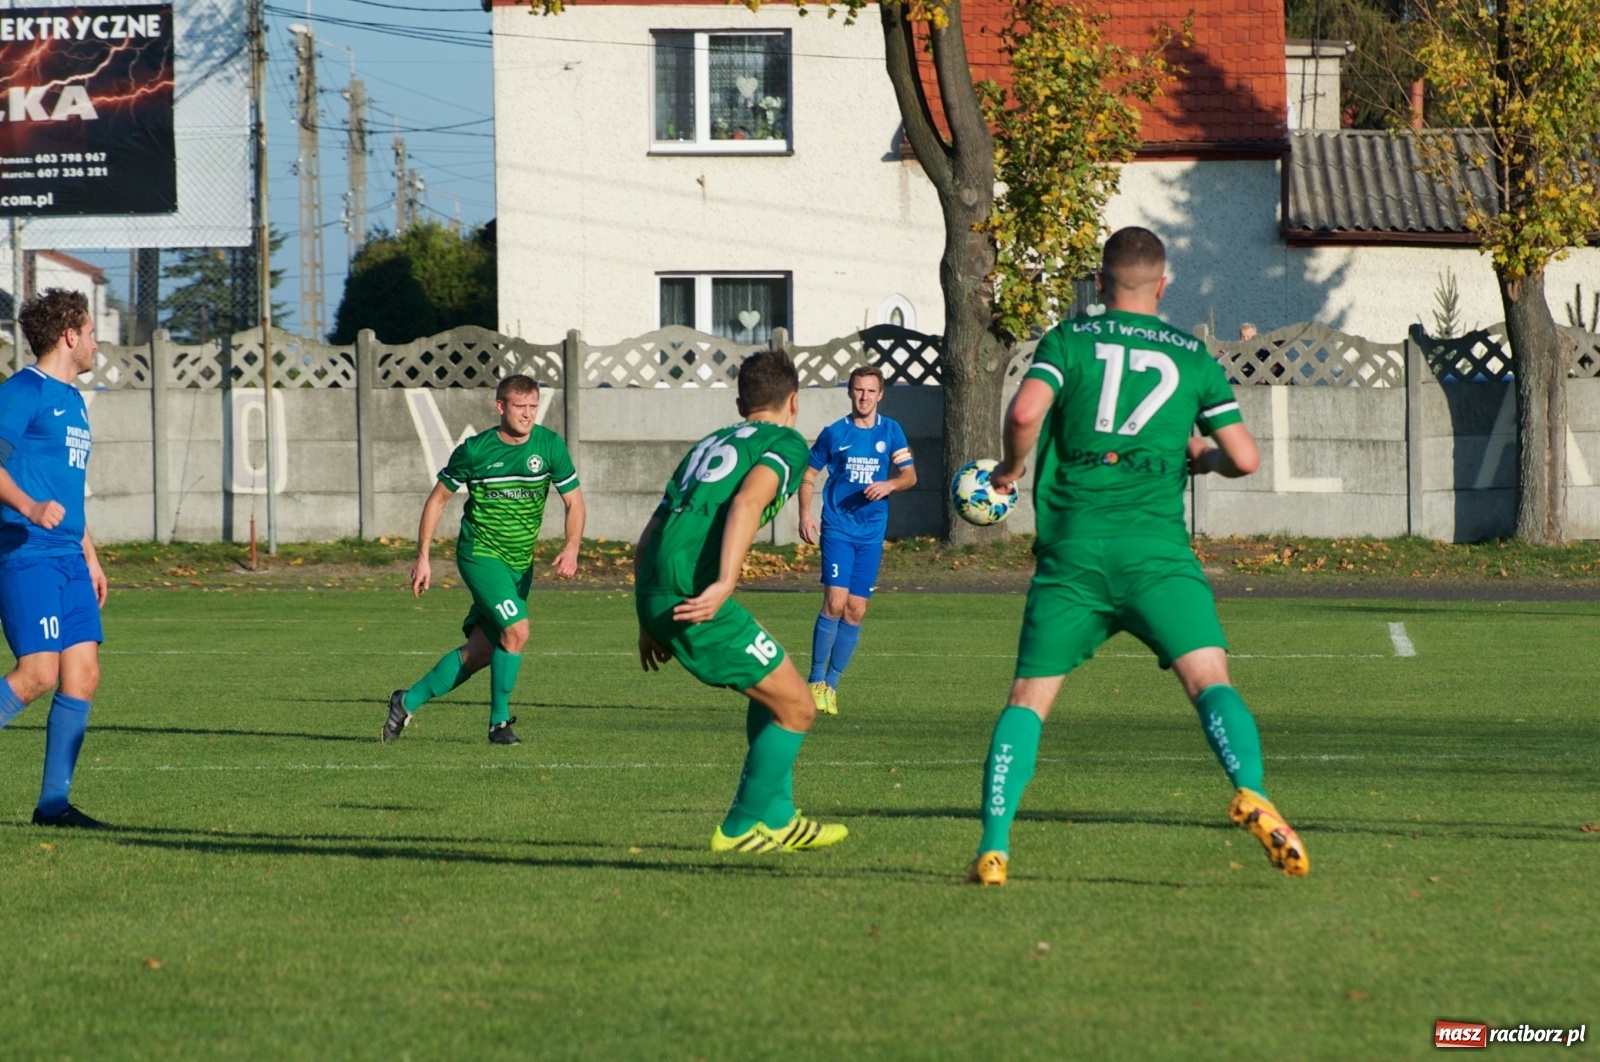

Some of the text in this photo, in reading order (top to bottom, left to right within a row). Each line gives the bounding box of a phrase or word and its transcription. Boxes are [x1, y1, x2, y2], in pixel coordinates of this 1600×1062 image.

[0, 14, 161, 41] EKTRYCZNE
[0, 85, 99, 122] KA
[35, 153, 58, 164] 603
[60, 153, 82, 163] 798
[85, 152, 107, 162] 967
[37, 168, 59, 178] 607
[62, 167, 84, 178] 336
[87, 167, 108, 177] 321
[849, 470, 874, 484] PIK
[831, 563, 839, 578] 3
[495, 599, 519, 621] 10
[39, 615, 60, 640] 10
[745, 630, 778, 667] 16
